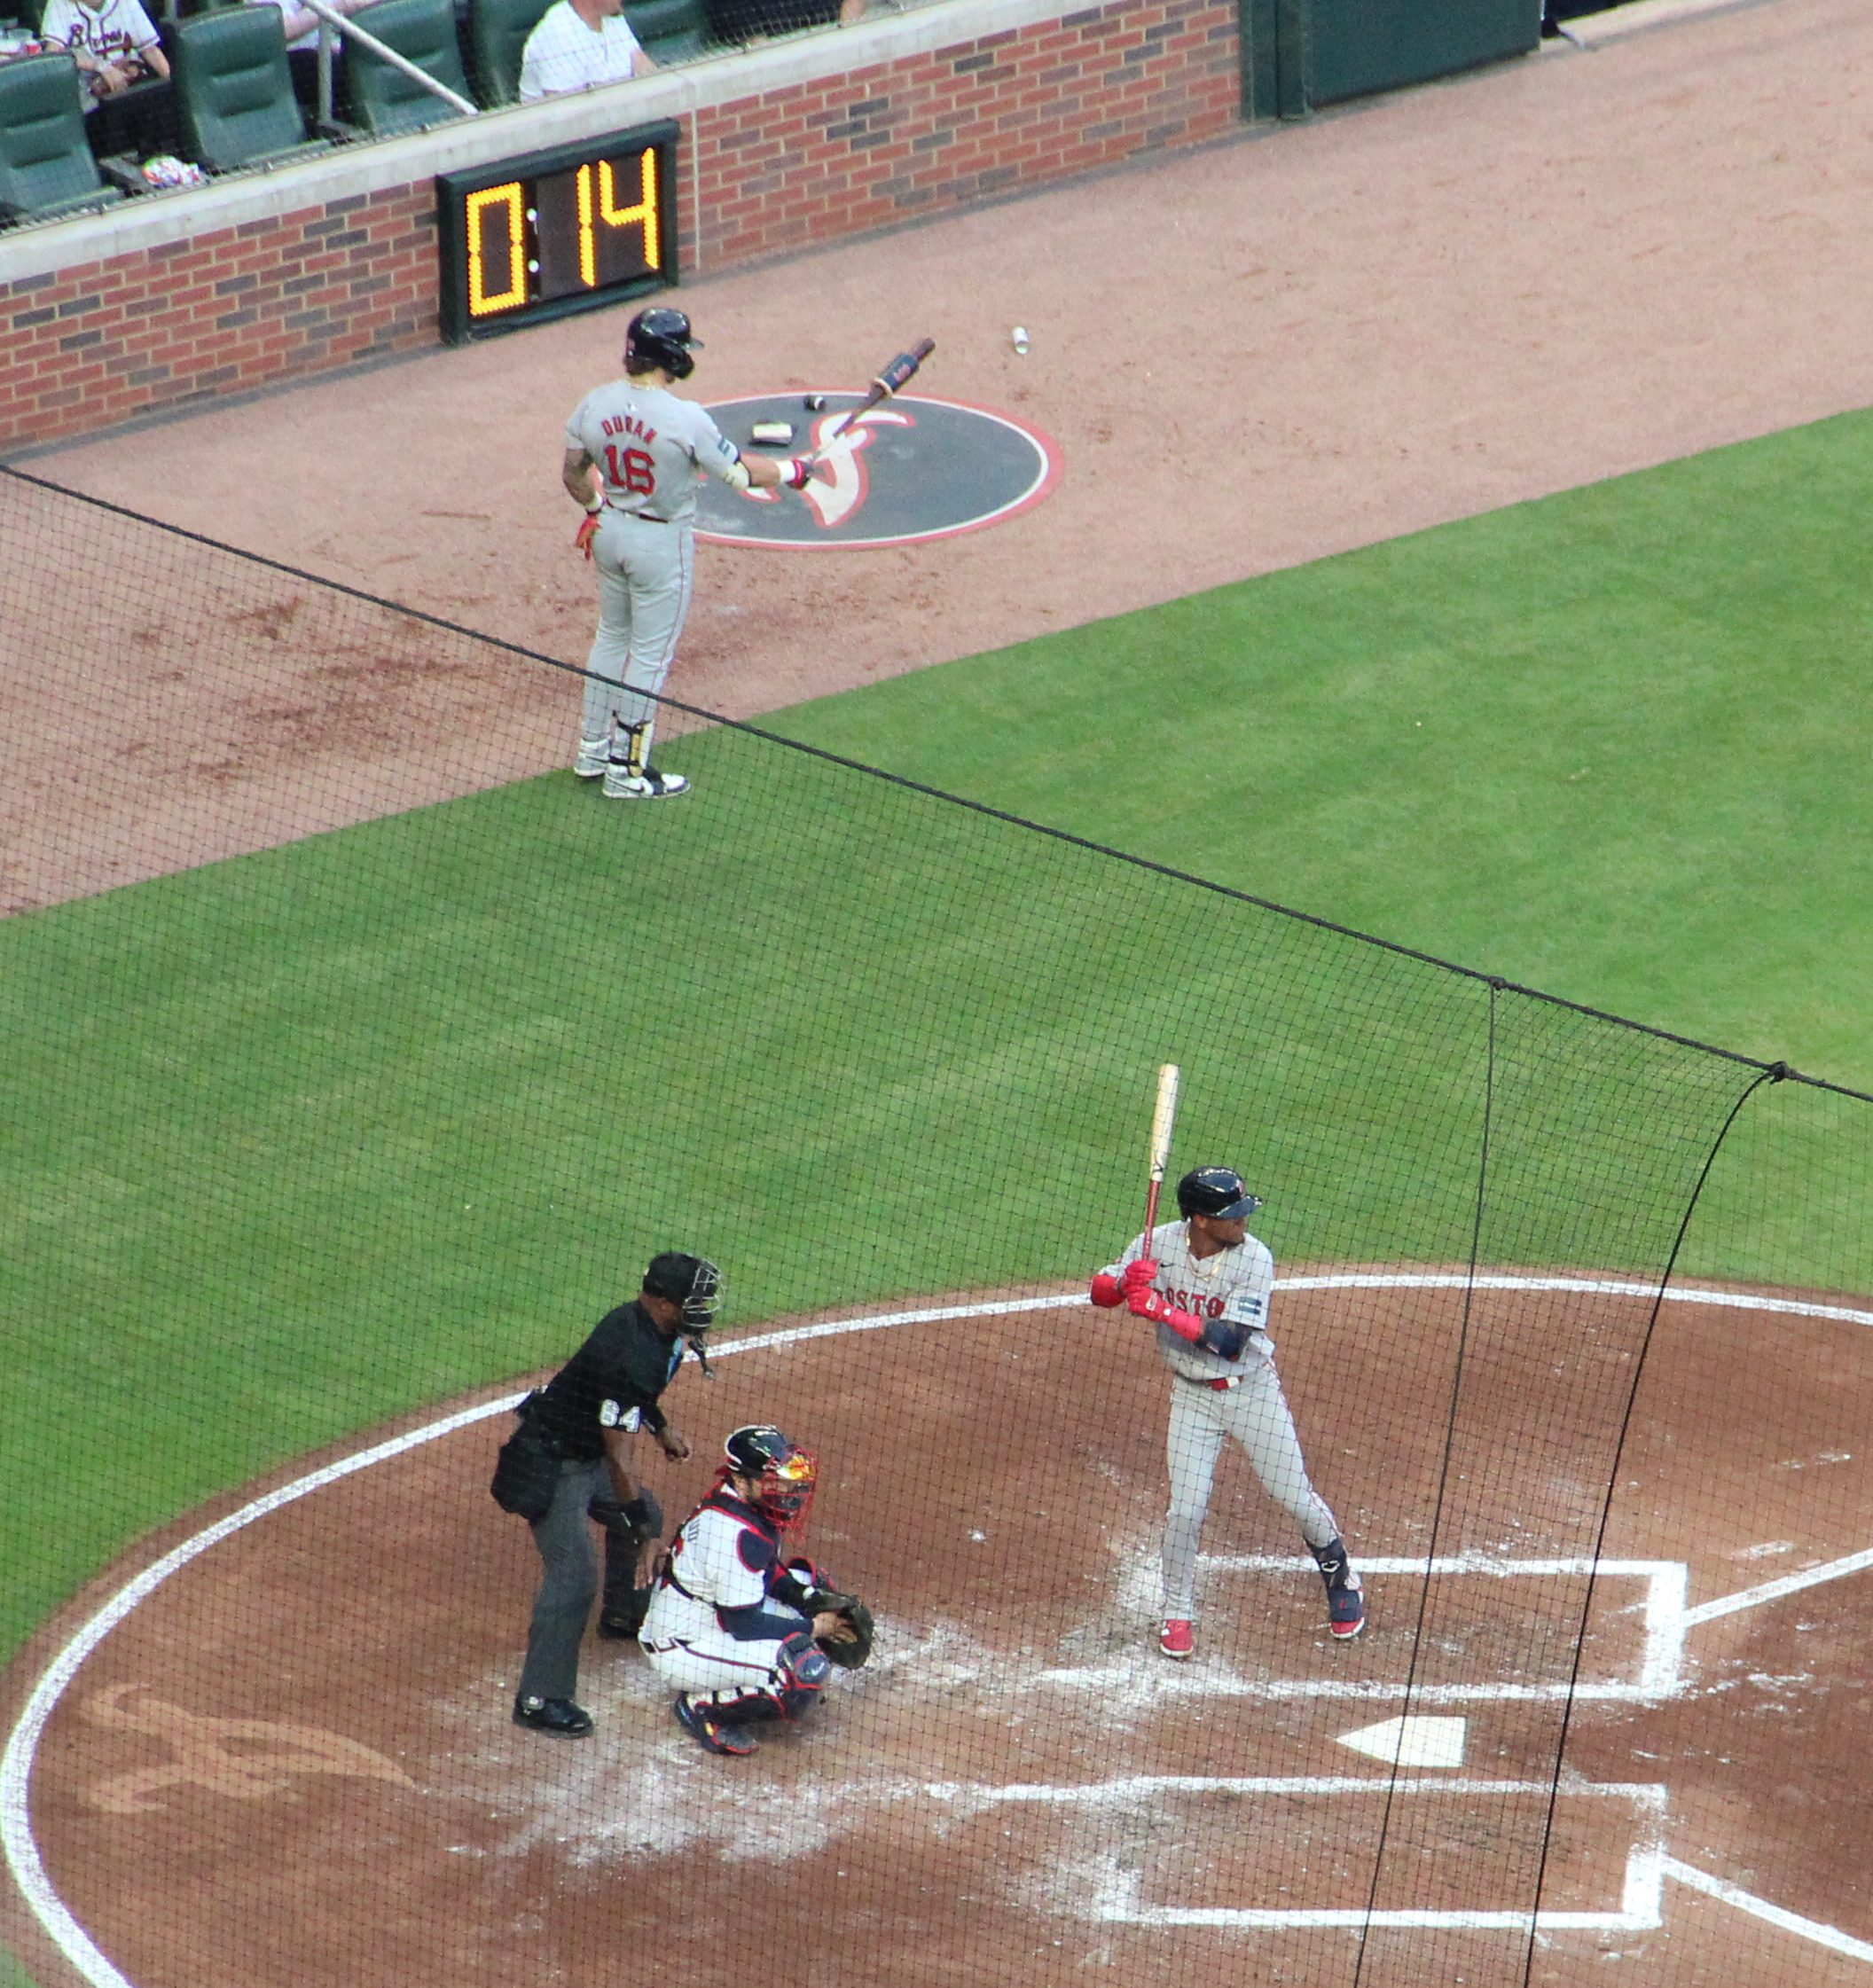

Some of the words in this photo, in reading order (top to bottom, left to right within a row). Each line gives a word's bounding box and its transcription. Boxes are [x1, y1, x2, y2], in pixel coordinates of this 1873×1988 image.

[466, 146, 659, 317] 0:14
[601, 414, 657, 445] DURAN
[605, 444, 656, 497] 16
[1152, 1287, 1226, 1319] OSTO
